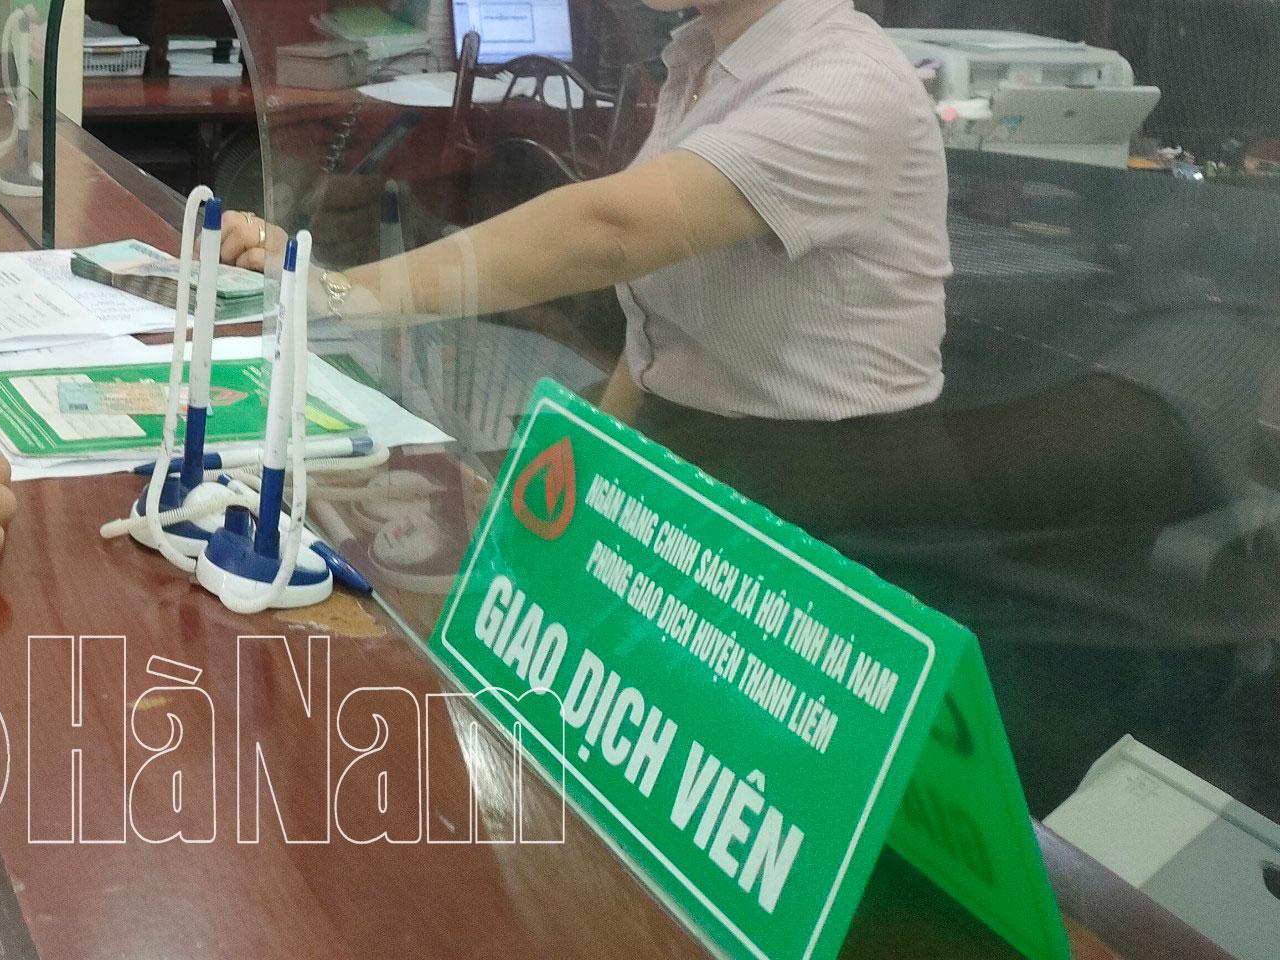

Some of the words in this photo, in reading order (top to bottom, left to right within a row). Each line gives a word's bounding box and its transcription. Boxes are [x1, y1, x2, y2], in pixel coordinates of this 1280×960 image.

[618, 495, 660, 548] HÀNG
[653, 521, 702, 577] CHÍNH
[694, 548, 740, 604] SÁCH
[731, 574, 764, 620] XÃ
[754, 589, 792, 641] HỘI
[821, 633, 855, 684] HÀ
[846, 651, 899, 714] NAM
[627, 571, 664, 621] GIAO
[656, 593, 699, 647] DỊCH
[689, 617, 746, 683] HUYỆN
[738, 652, 797, 723] THANH
[788, 691, 839, 755] LIÊM
[474, 574, 568, 695] GIAO
[560, 648, 678, 798] DỊCH
[670, 740, 805, 914] VIÊN
